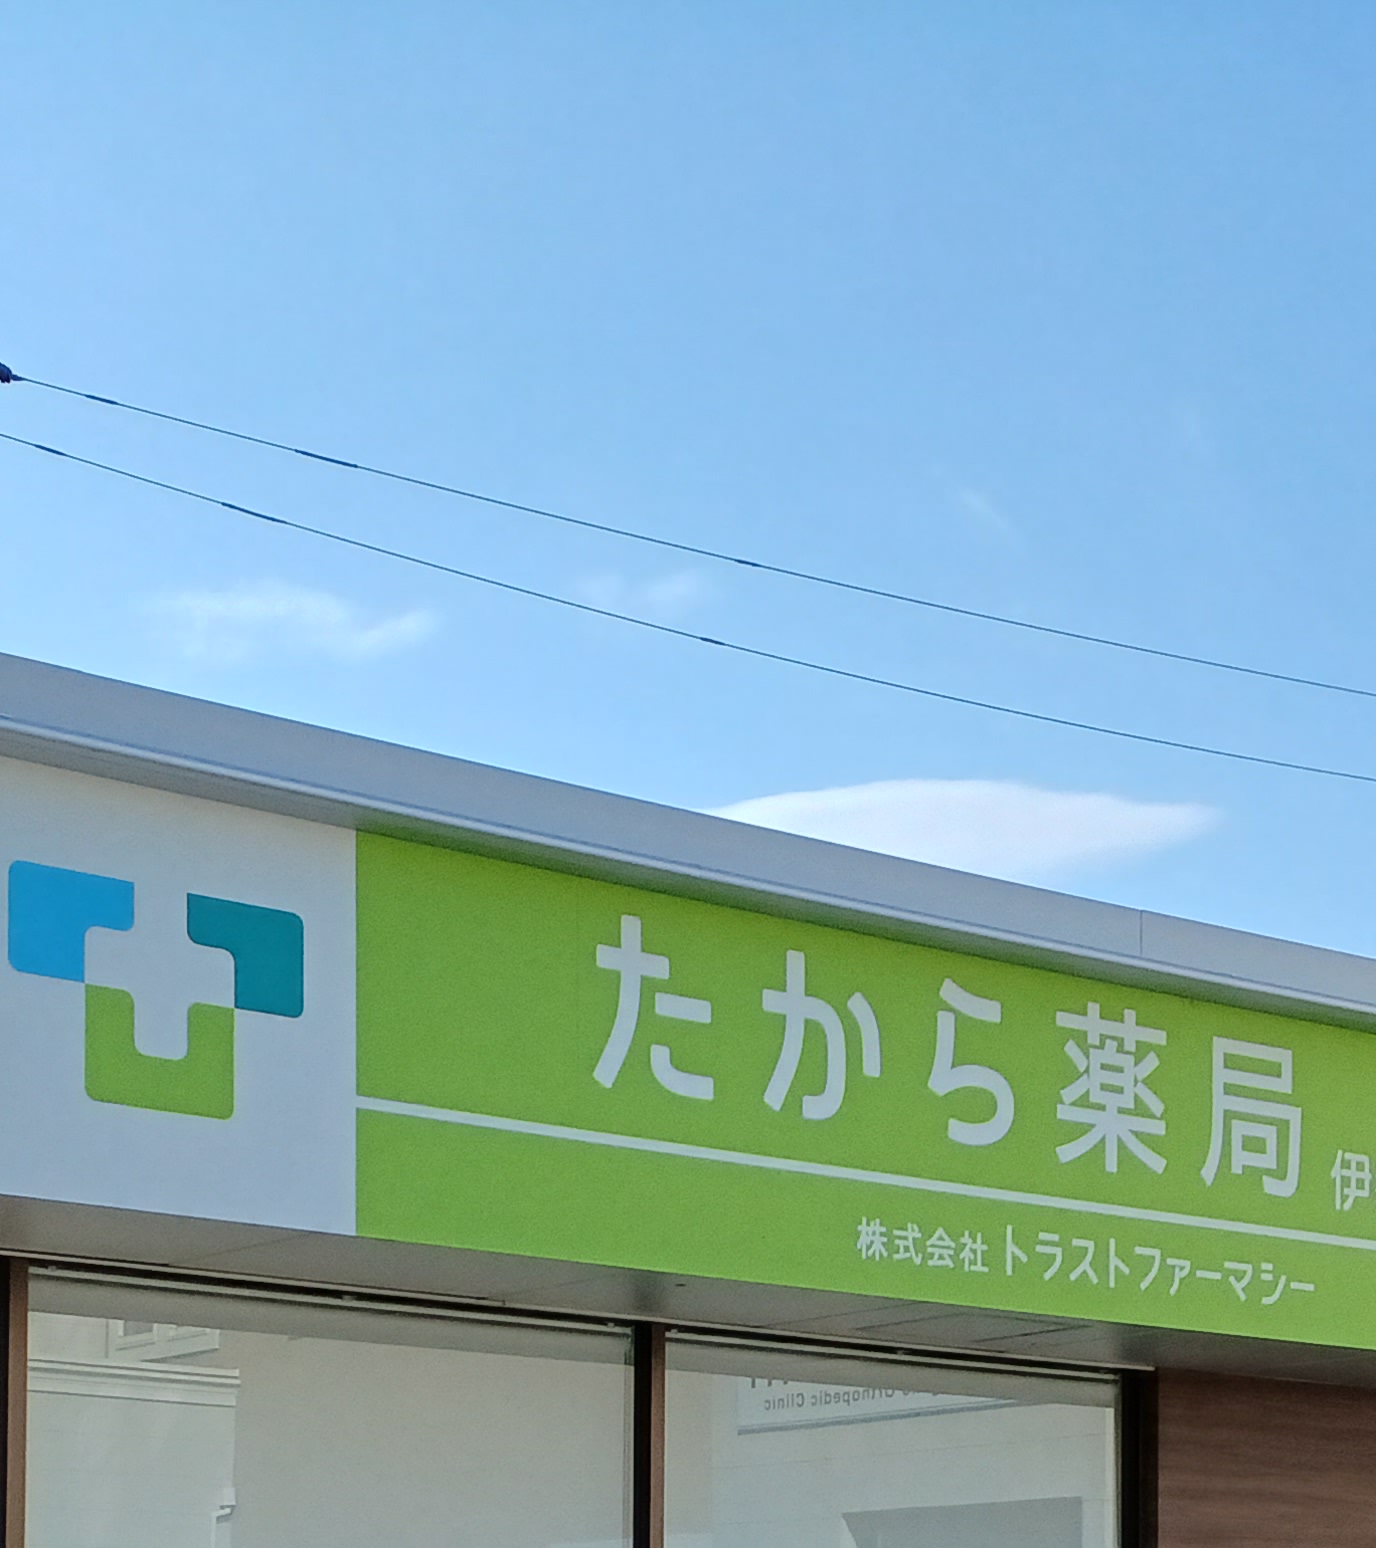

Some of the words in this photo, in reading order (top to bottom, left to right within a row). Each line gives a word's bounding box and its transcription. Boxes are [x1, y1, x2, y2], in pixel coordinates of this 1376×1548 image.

[593, 914, 1304, 1198] たから薬局
[856, 1216, 989, 1273] 株式会社
[1005, 1224, 1315, 1305] トラストファーマシー
